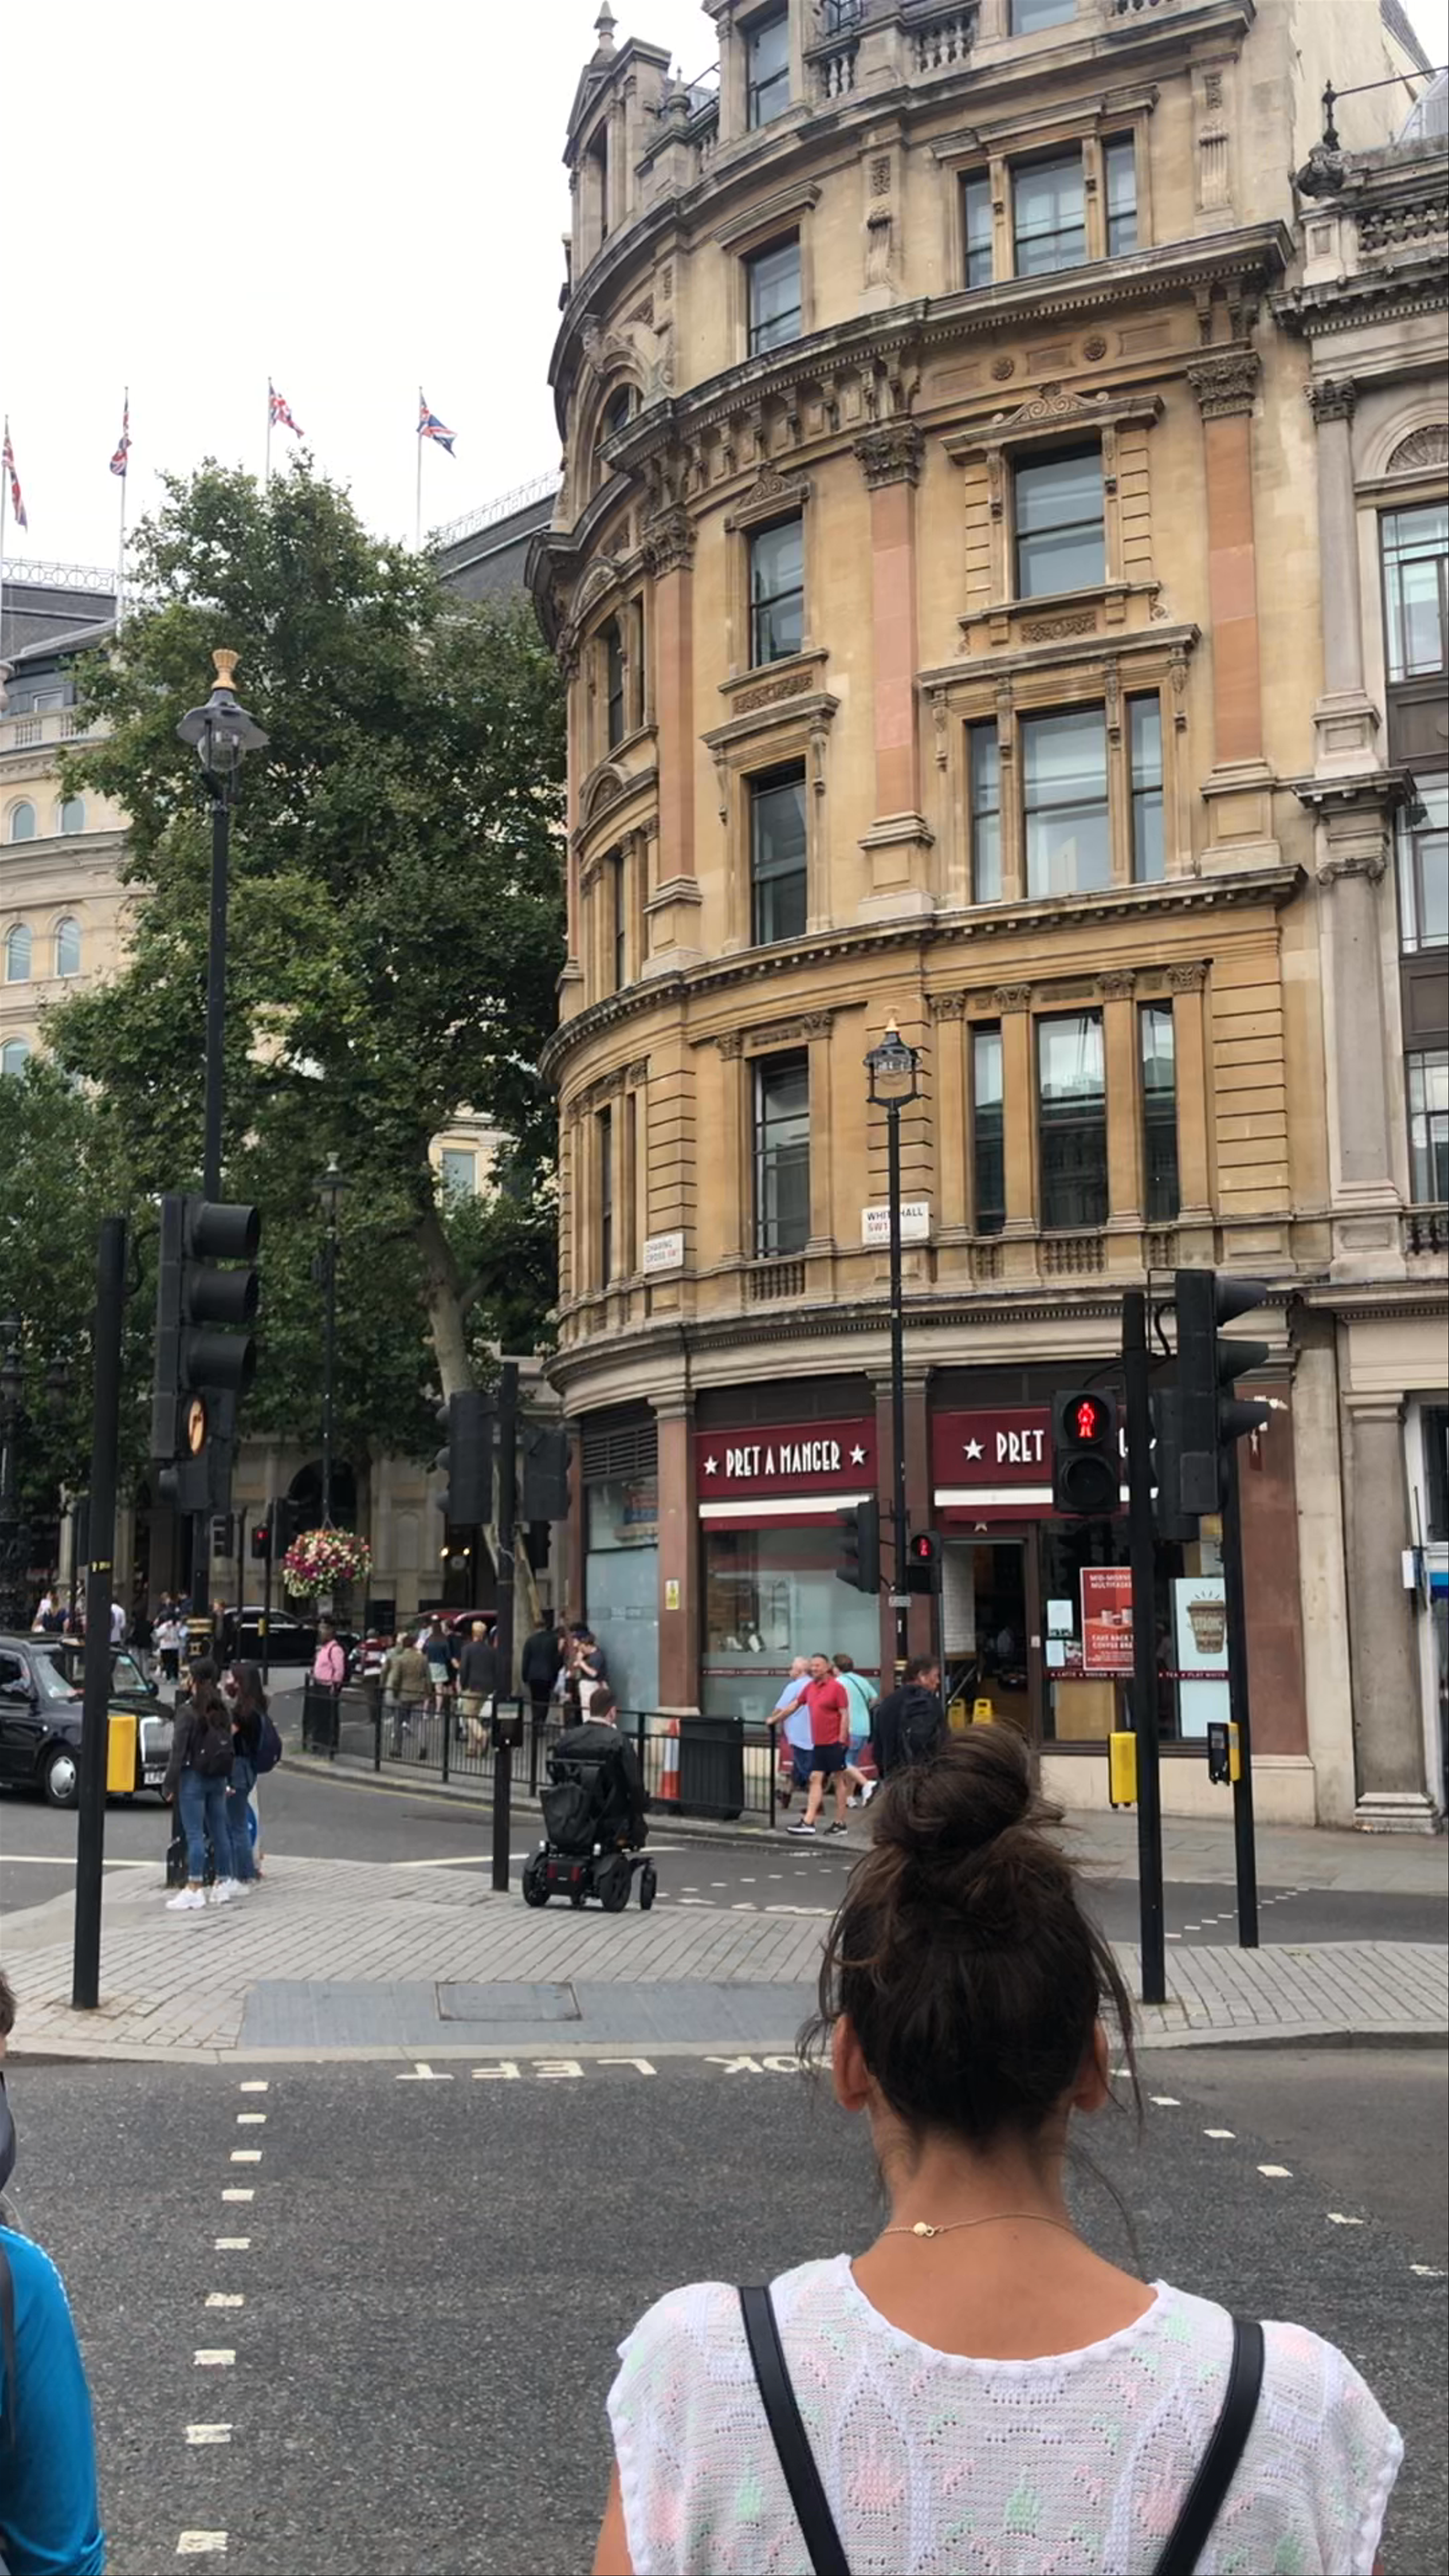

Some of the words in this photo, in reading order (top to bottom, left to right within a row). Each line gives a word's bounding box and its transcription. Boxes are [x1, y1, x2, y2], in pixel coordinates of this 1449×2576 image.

[726, 1446, 761, 1477] PRET
[765, 1446, 775, 1475] A
[780, 1439, 841, 1474] MANGER
[997, 1430, 1044, 1463] PRET
[396, 2058, 657, 2079] LEFT
